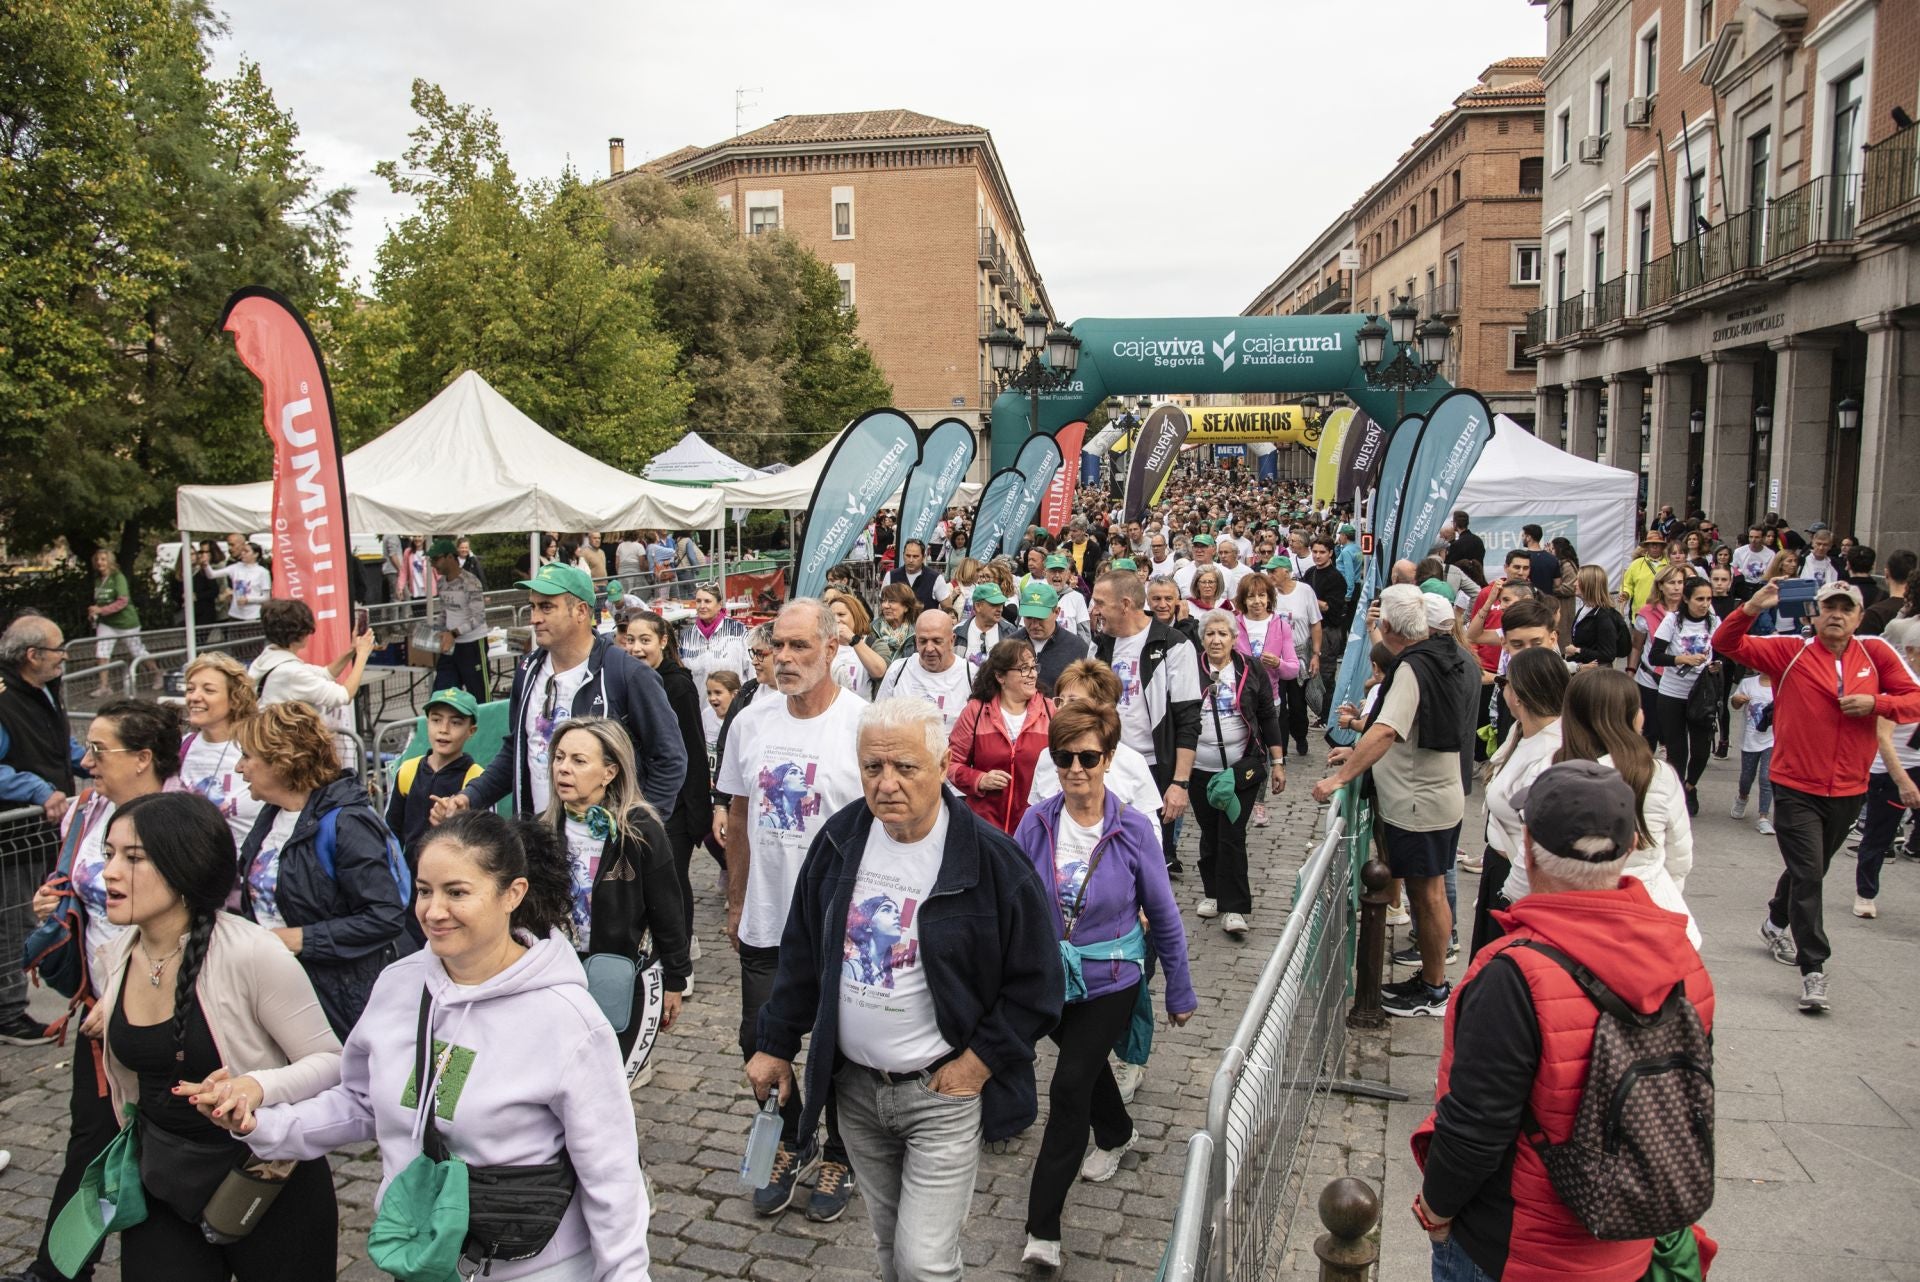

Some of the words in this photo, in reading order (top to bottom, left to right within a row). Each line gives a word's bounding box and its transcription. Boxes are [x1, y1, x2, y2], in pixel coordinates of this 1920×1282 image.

[1113, 336, 1205, 361] cajaviva
[1242, 332, 1342, 358] cajarural
[1154, 356, 1205, 368] Segovia
[1242, 353, 1314, 365] Fundación
[1203, 412, 1292, 434] SEXMEROS
[1144, 453, 1160, 471] YOU
[1218, 446, 1244, 454] META
[1352, 452, 1369, 471] YOU
[1440, 415, 1480, 480] cajarural
[859, 436, 909, 497] cajarural
[807, 515, 849, 574] cajaviva
[829, 522, 854, 554] Segovia
[1362, 535, 1372, 553] 0
[648, 970, 661, 1006] FILA
[638, 1016, 658, 1051] FILA
